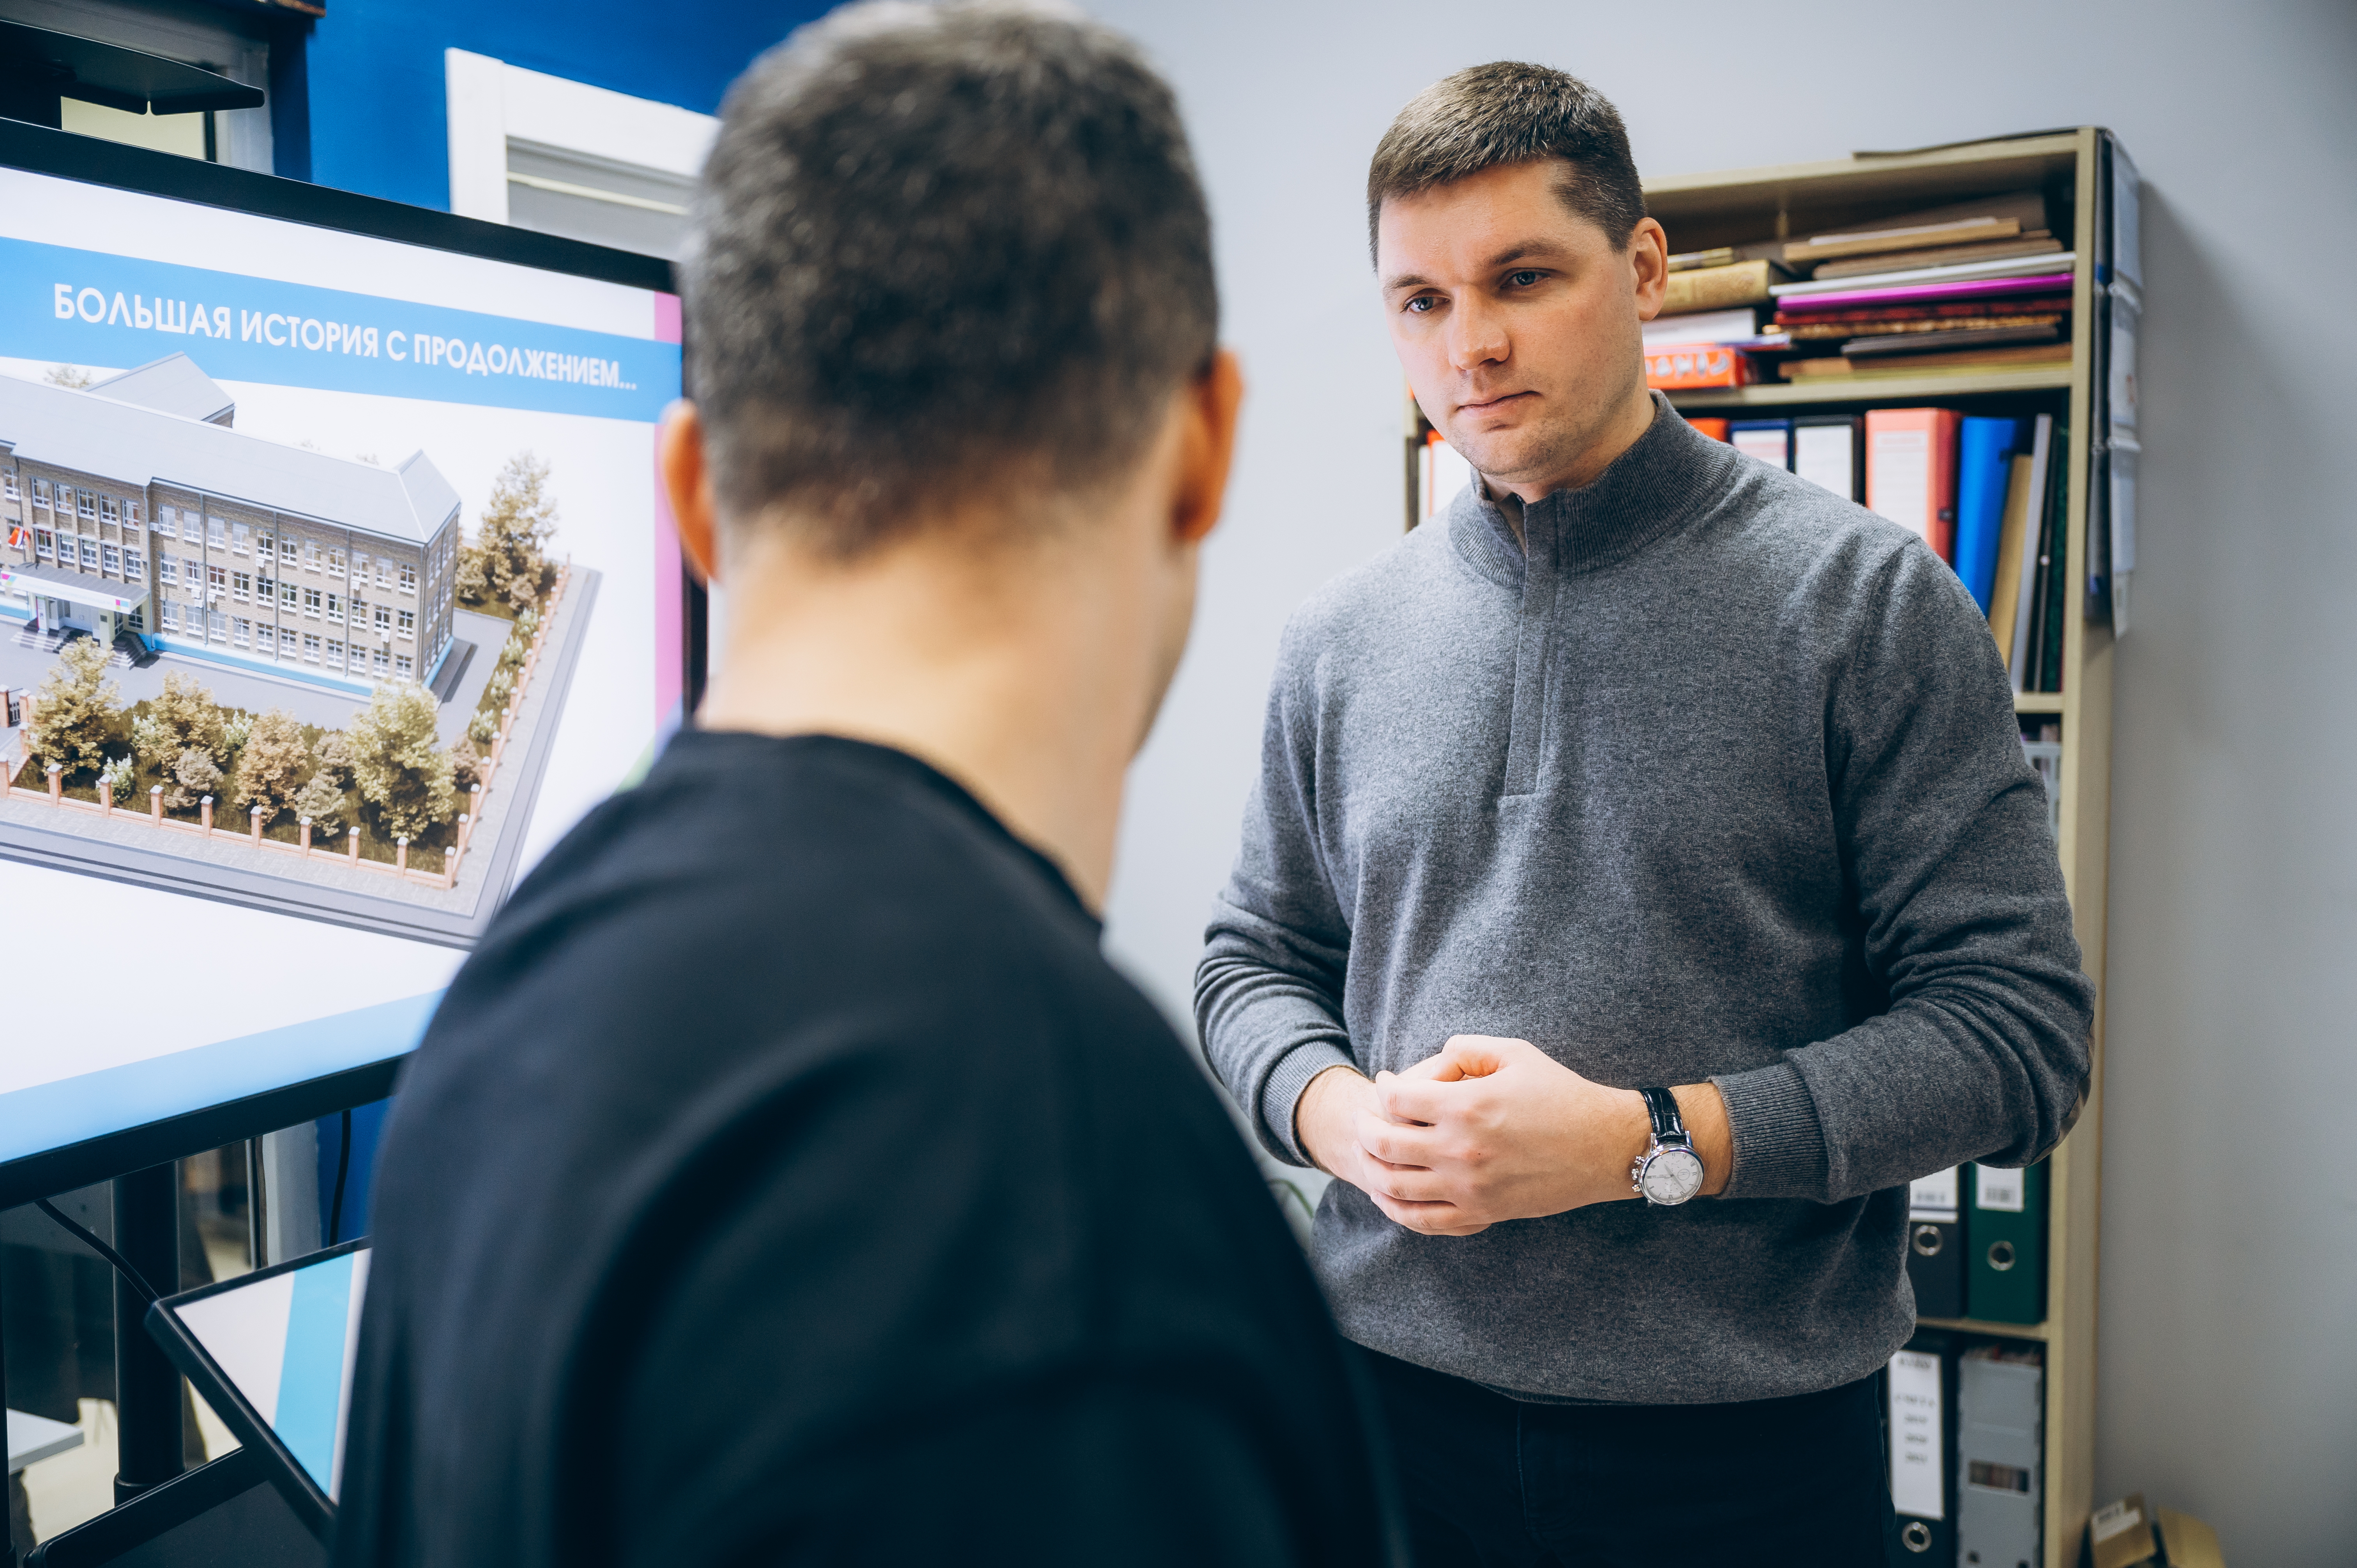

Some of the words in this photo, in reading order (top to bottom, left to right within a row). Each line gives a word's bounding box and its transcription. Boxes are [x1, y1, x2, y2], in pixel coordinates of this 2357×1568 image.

[54, 283, 231, 340] БОЛЬШАЯ
[241, 309, 379, 358] ИСТОРИЯ
[385, 330, 407, 362] С
[413, 333, 637, 390] ПРОДОЛЖЕНИЕМ...
